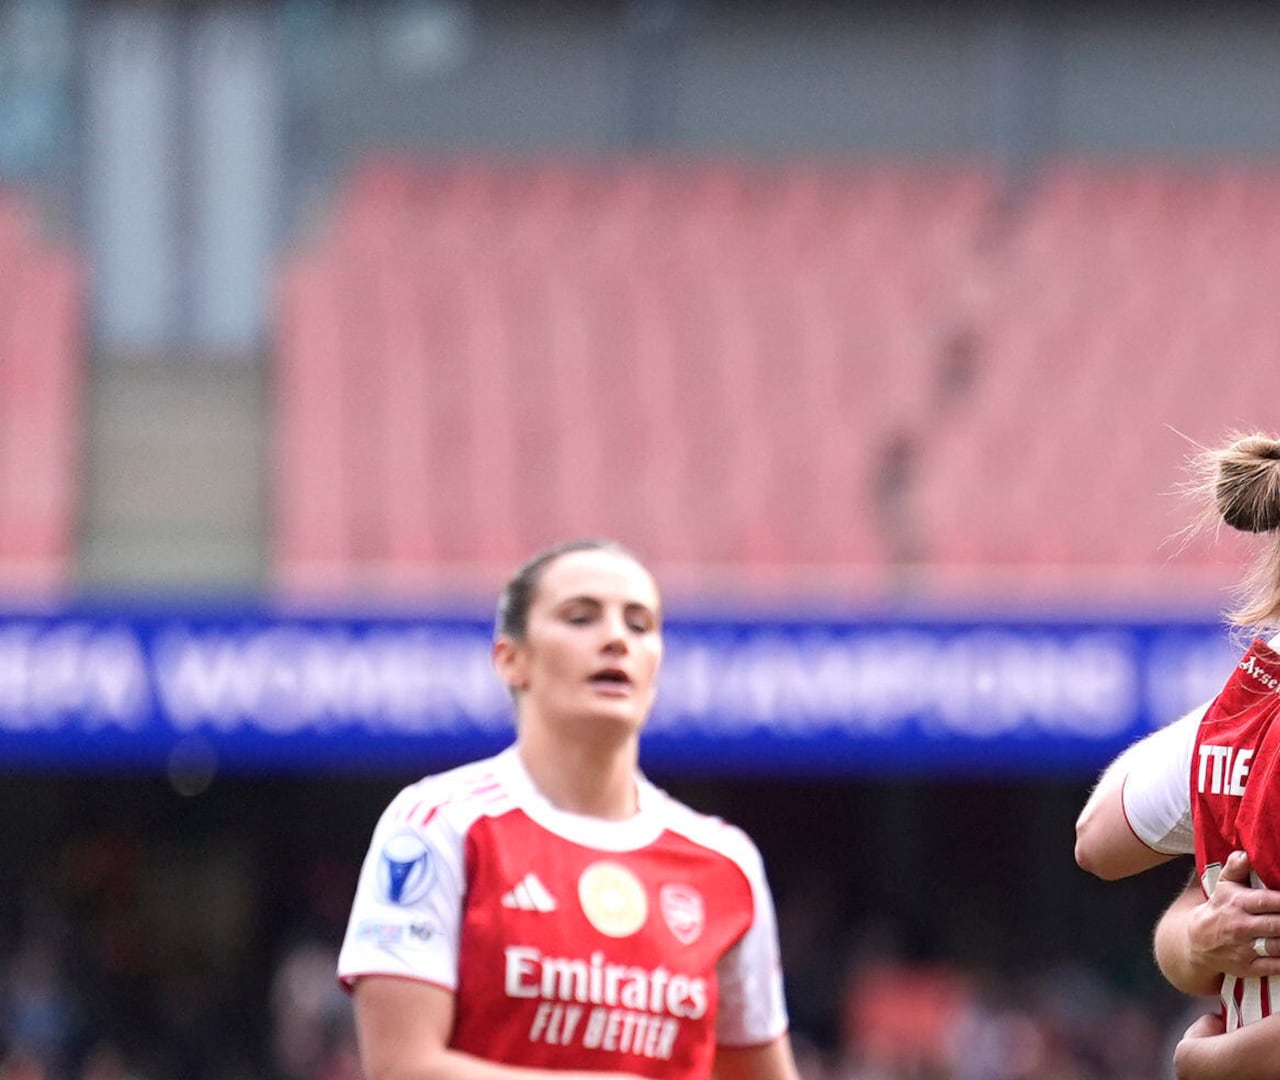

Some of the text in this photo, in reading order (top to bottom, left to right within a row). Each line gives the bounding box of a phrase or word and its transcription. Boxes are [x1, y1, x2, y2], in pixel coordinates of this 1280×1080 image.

[504, 945, 708, 1020] Emirates
[528, 1001, 679, 1061] FLY BETTER
